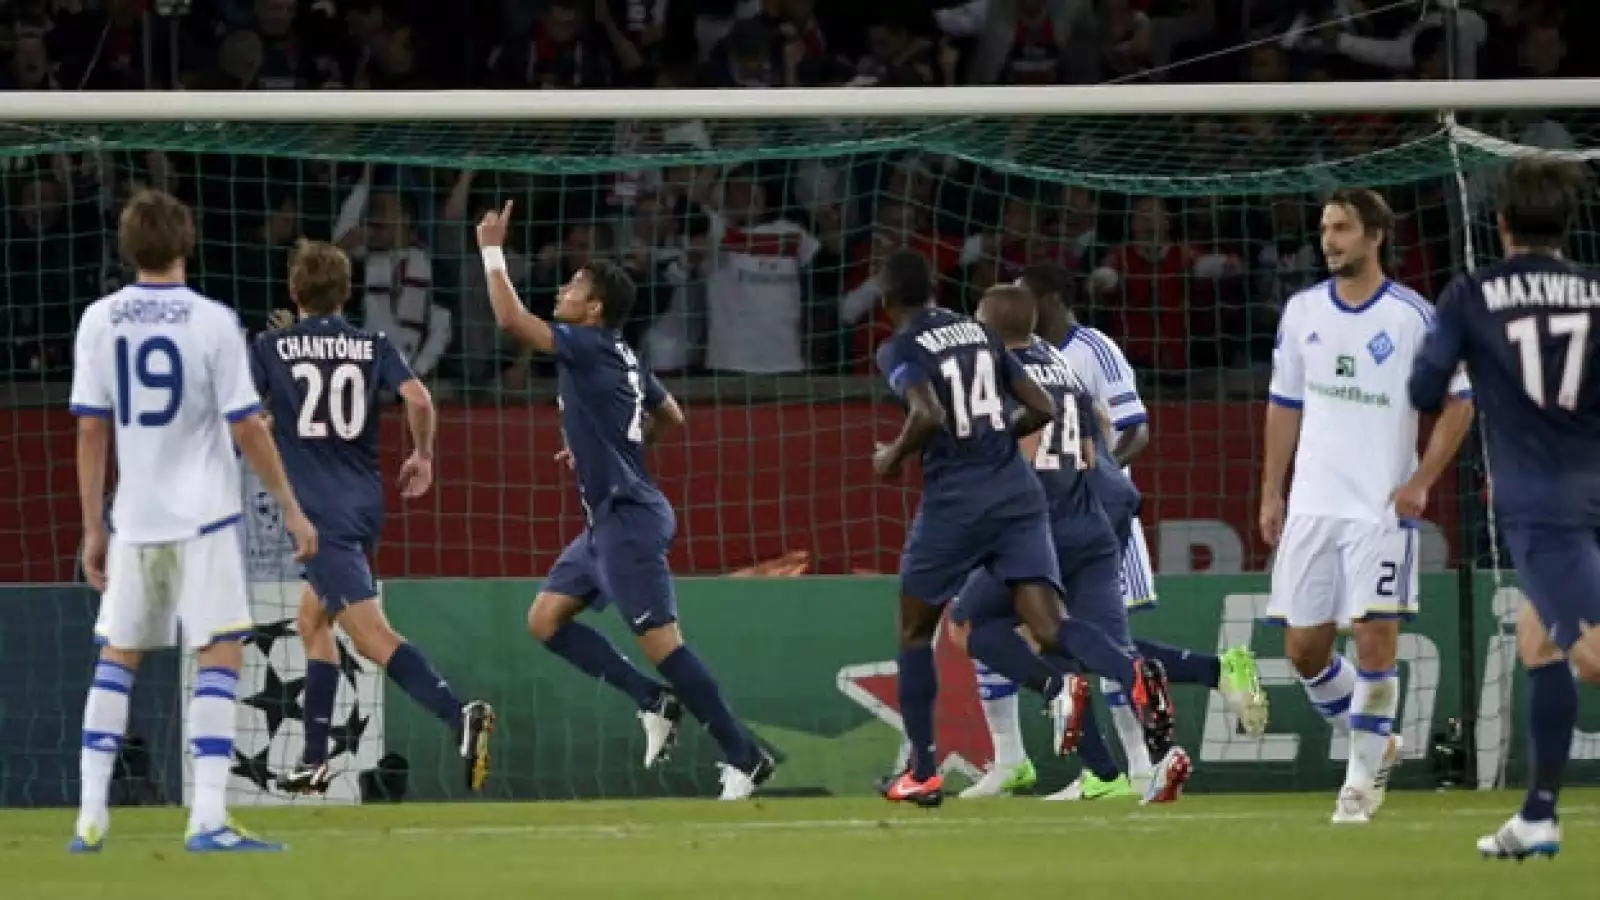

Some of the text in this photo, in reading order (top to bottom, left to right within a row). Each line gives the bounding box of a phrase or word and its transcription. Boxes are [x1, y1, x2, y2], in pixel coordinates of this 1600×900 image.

[1482, 272, 1600, 311] MAXWELL
[115, 335, 183, 427] 19
[276, 334, 373, 361] CHANTÔME
[1506, 313, 1591, 411] 17
[291, 364, 366, 441] 20
[940, 349, 1006, 438] 14
[1035, 393, 1088, 470] 24
[1376, 561, 1396, 597] 2
